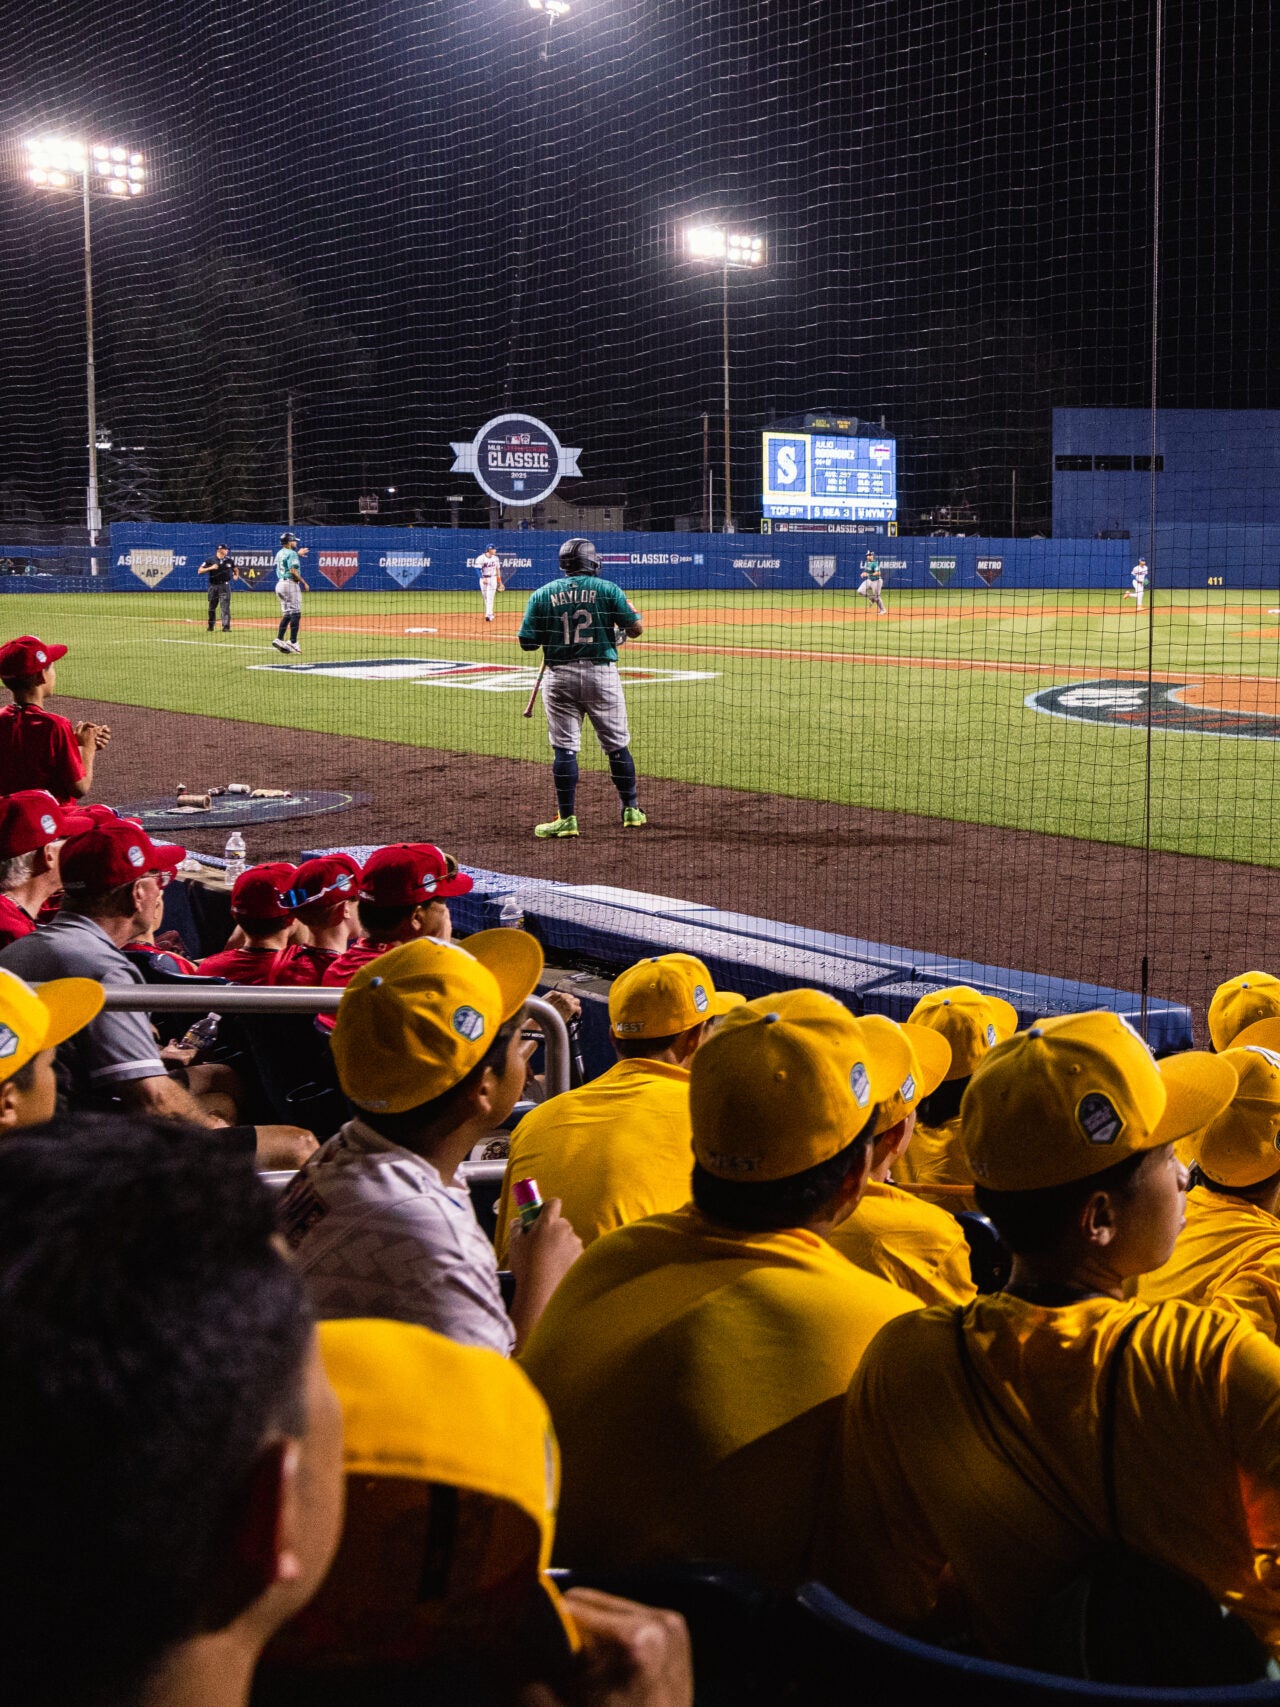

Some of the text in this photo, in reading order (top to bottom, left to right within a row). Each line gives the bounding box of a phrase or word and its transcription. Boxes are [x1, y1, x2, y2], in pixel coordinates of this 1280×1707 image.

[488, 452, 549, 468] CLASSIC
[777, 446, 798, 485] S
[828, 523, 857, 534] CLASSIC
[319, 556, 359, 567] CANADA
[630, 553, 669, 565] CLASSIC
[733, 559, 782, 569] GREAT LAKES
[929, 561, 956, 569] MEXICO
[977, 561, 1002, 569] METRO
[145, 568, 159, 578] AP
[1207, 576, 1224, 586] 411
[550, 589, 598, 608] NAYLOR
[559, 608, 594, 645] 12
[616, 1022, 645, 1033] WEST
